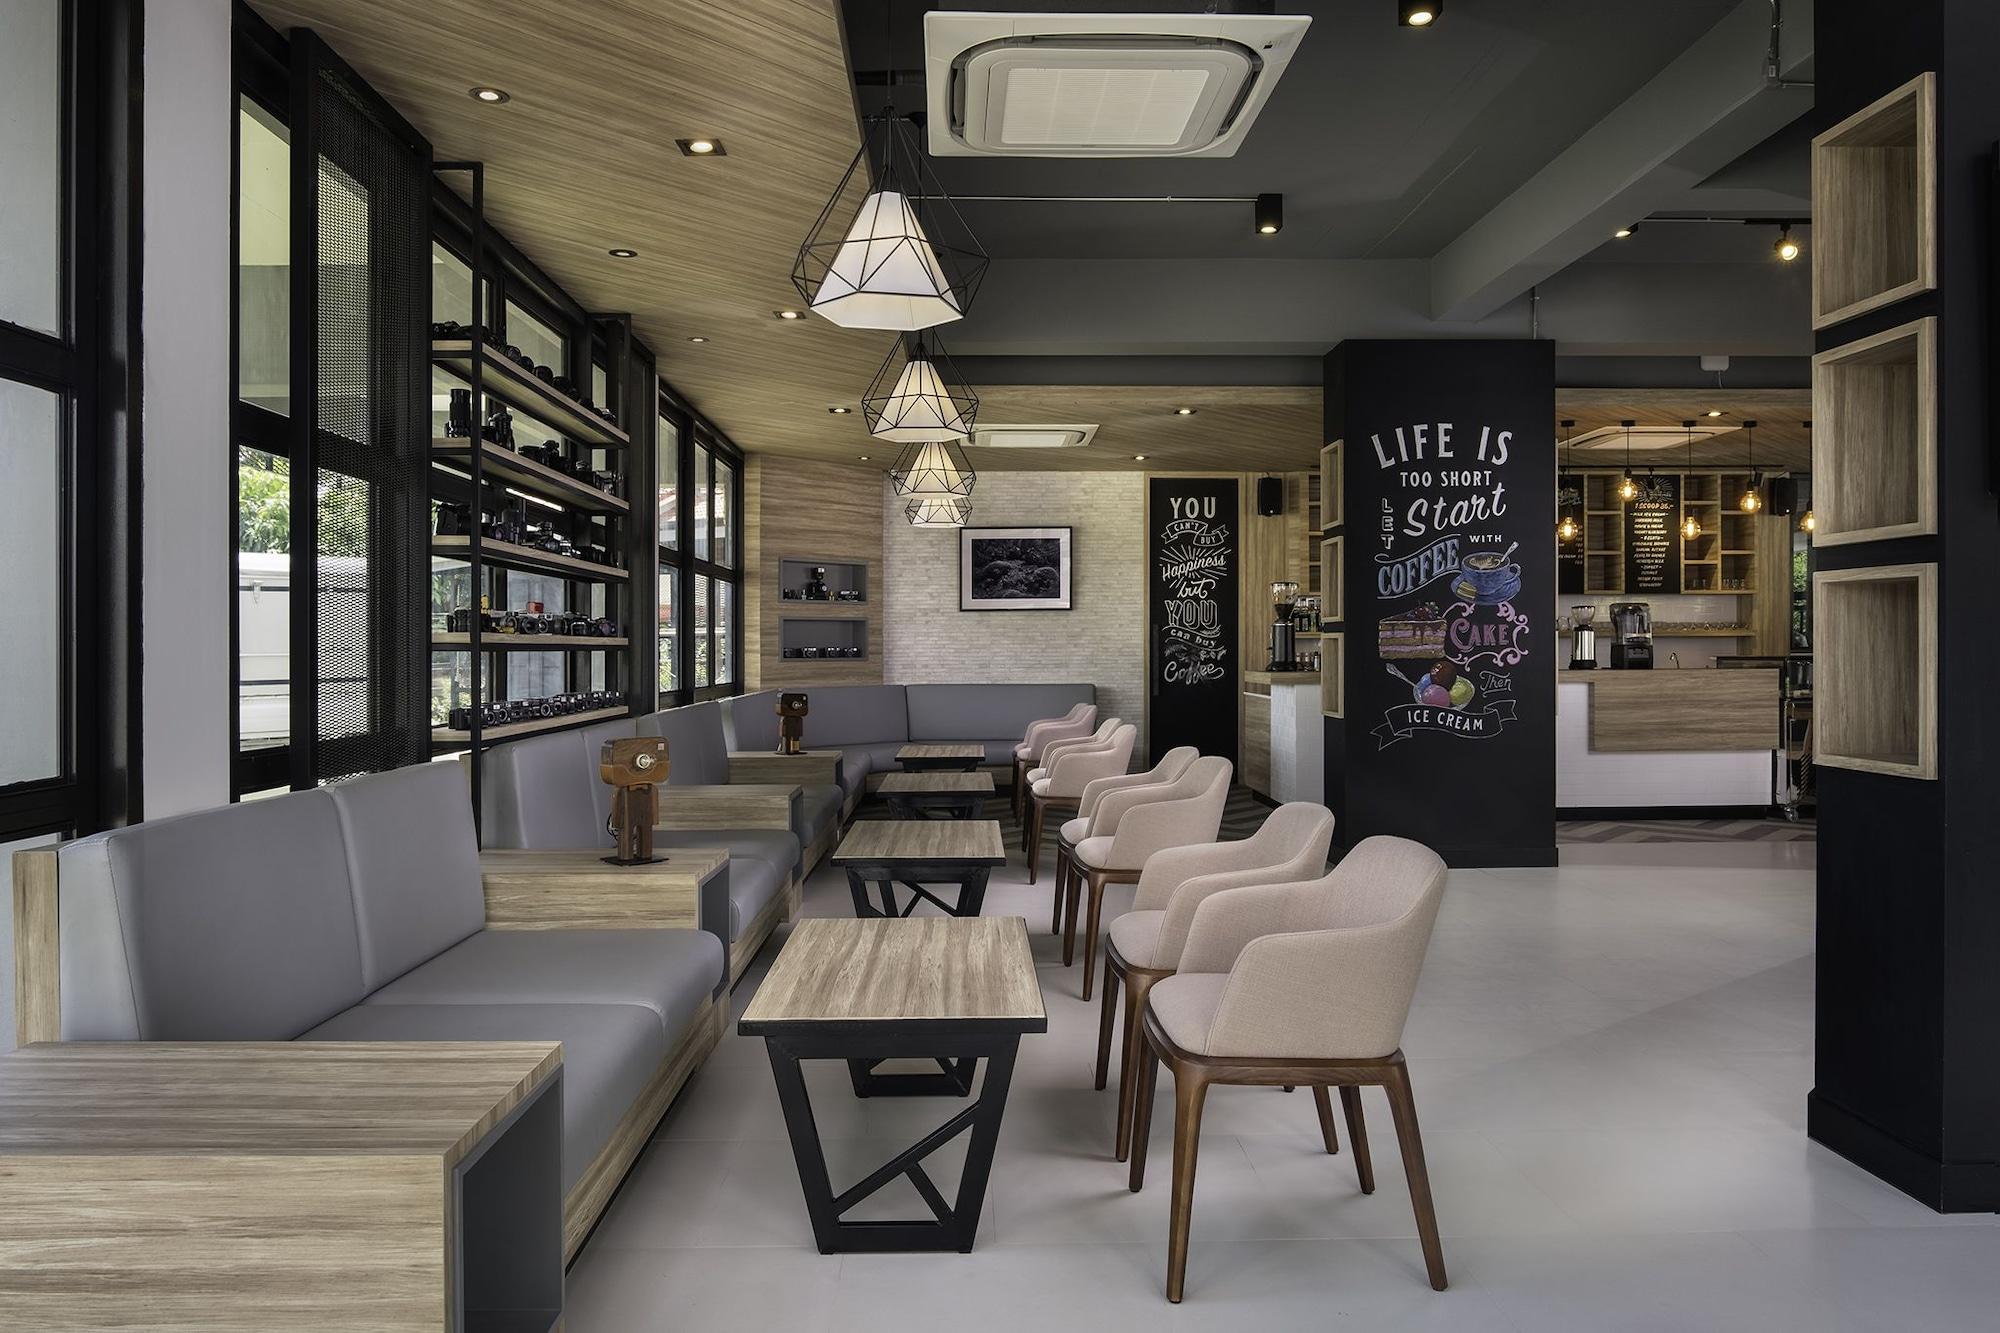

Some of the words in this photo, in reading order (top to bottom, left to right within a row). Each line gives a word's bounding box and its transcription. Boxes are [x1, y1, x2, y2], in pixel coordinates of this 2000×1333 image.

[1371, 423, 1454, 469] LIFE
[1477, 426, 1513, 466] IS
[1400, 472, 1432, 487] TOO
[1441, 471, 1492, 487] SHORT
[1169, 496, 1216, 519] YOU
[1402, 482, 1507, 537] Start
[1174, 522, 1199, 531] CAN'T
[1200, 536, 1216, 544] BUY
[1381, 497, 1394, 550] LET
[1469, 534, 1502, 543] WITH
[1162, 555, 1226, 581] Happiness
[1377, 538, 1461, 596] COFFEE
[1177, 578, 1216, 599] but
[1164, 599, 1218, 630] YOU
[1450, 618, 1510, 652] CAKE
[1164, 661, 1224, 685] Coffee
[1479, 670, 1512, 698] Then
[1407, 710, 1430, 723] ICE
[1437, 712, 1484, 731] CREAM
